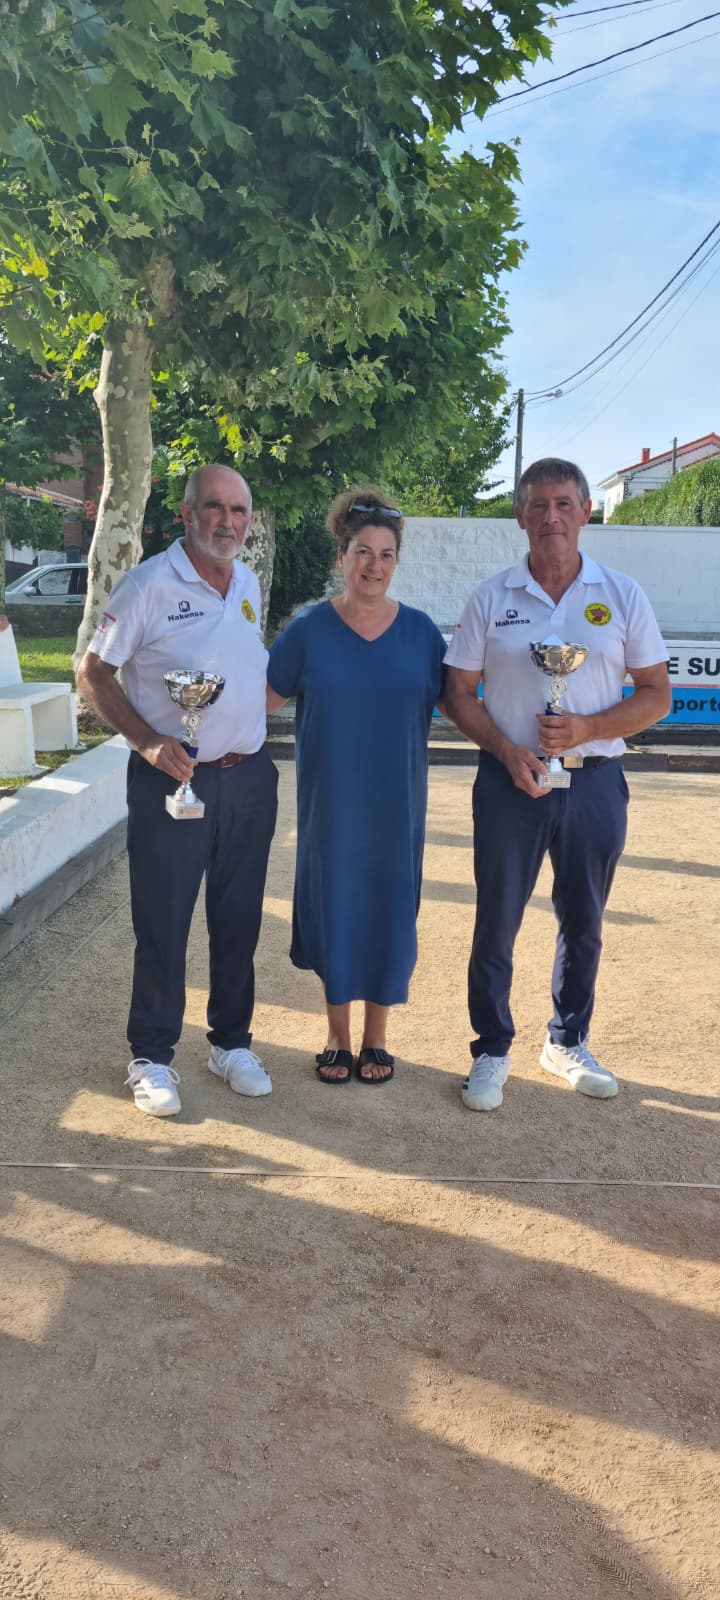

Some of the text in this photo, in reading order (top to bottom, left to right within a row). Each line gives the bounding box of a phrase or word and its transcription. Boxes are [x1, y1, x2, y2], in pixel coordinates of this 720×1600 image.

[167, 610, 204, 622] Hakensa
[495, 618, 530, 628] Hakensa
[672, 697, 720, 715] port
